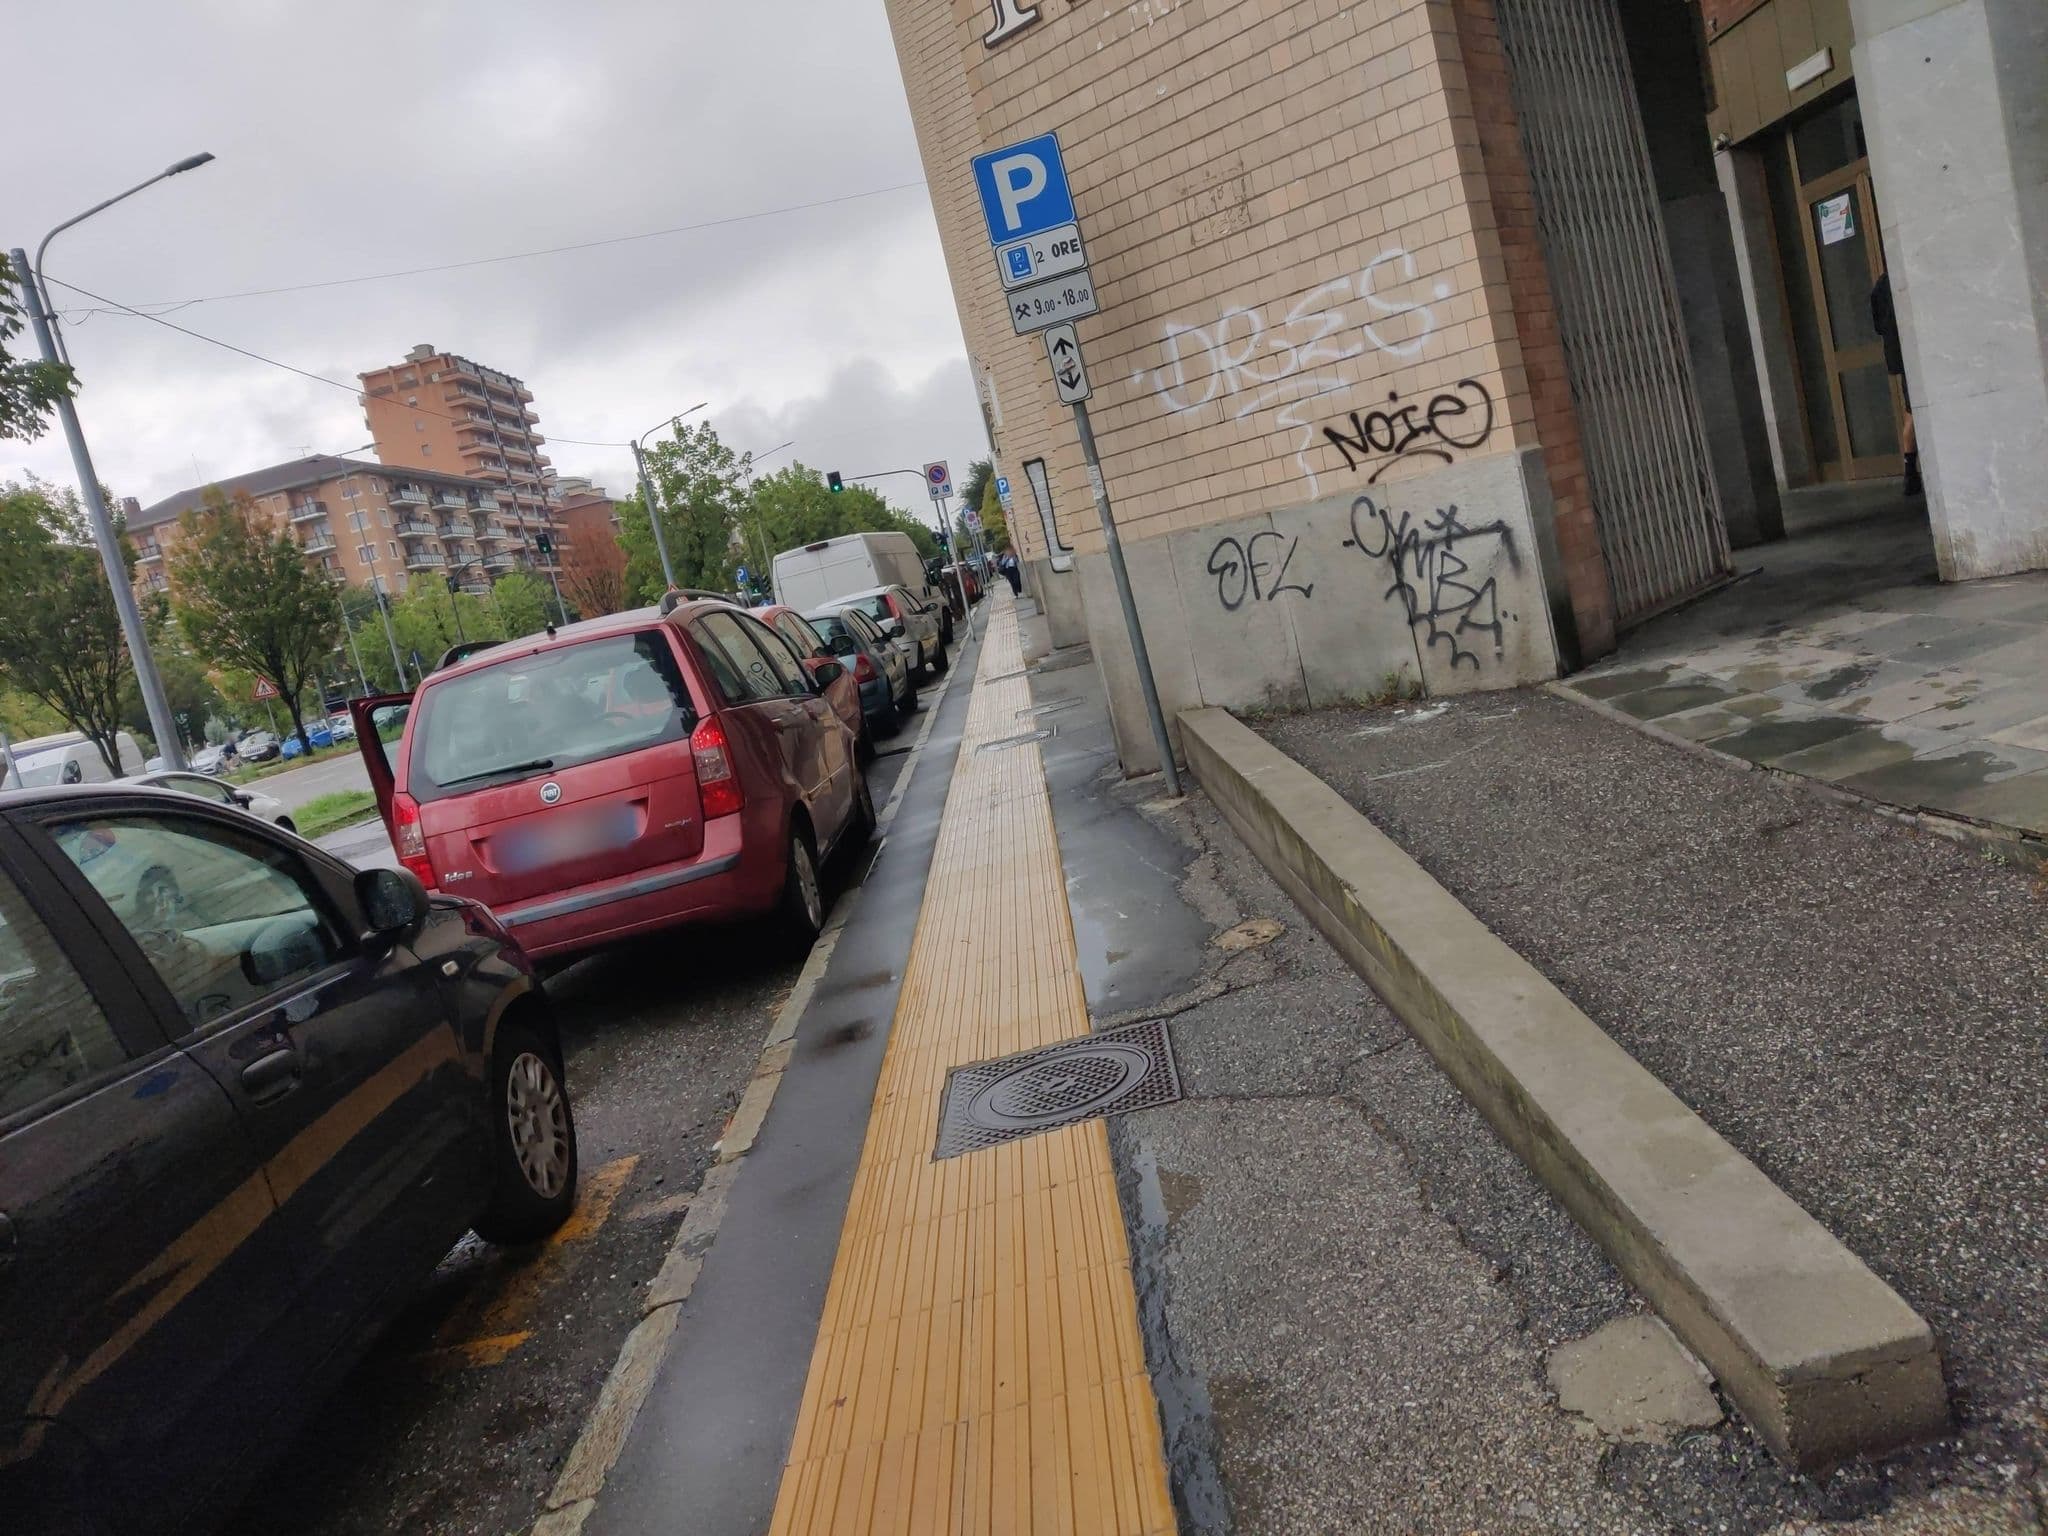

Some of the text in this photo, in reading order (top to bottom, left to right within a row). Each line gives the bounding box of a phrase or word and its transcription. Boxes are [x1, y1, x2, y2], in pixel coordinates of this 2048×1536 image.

[991, 153, 1048, 231] P
[1035, 239, 1080, 263] 2 ORE
[998, 479, 1007, 494] P
